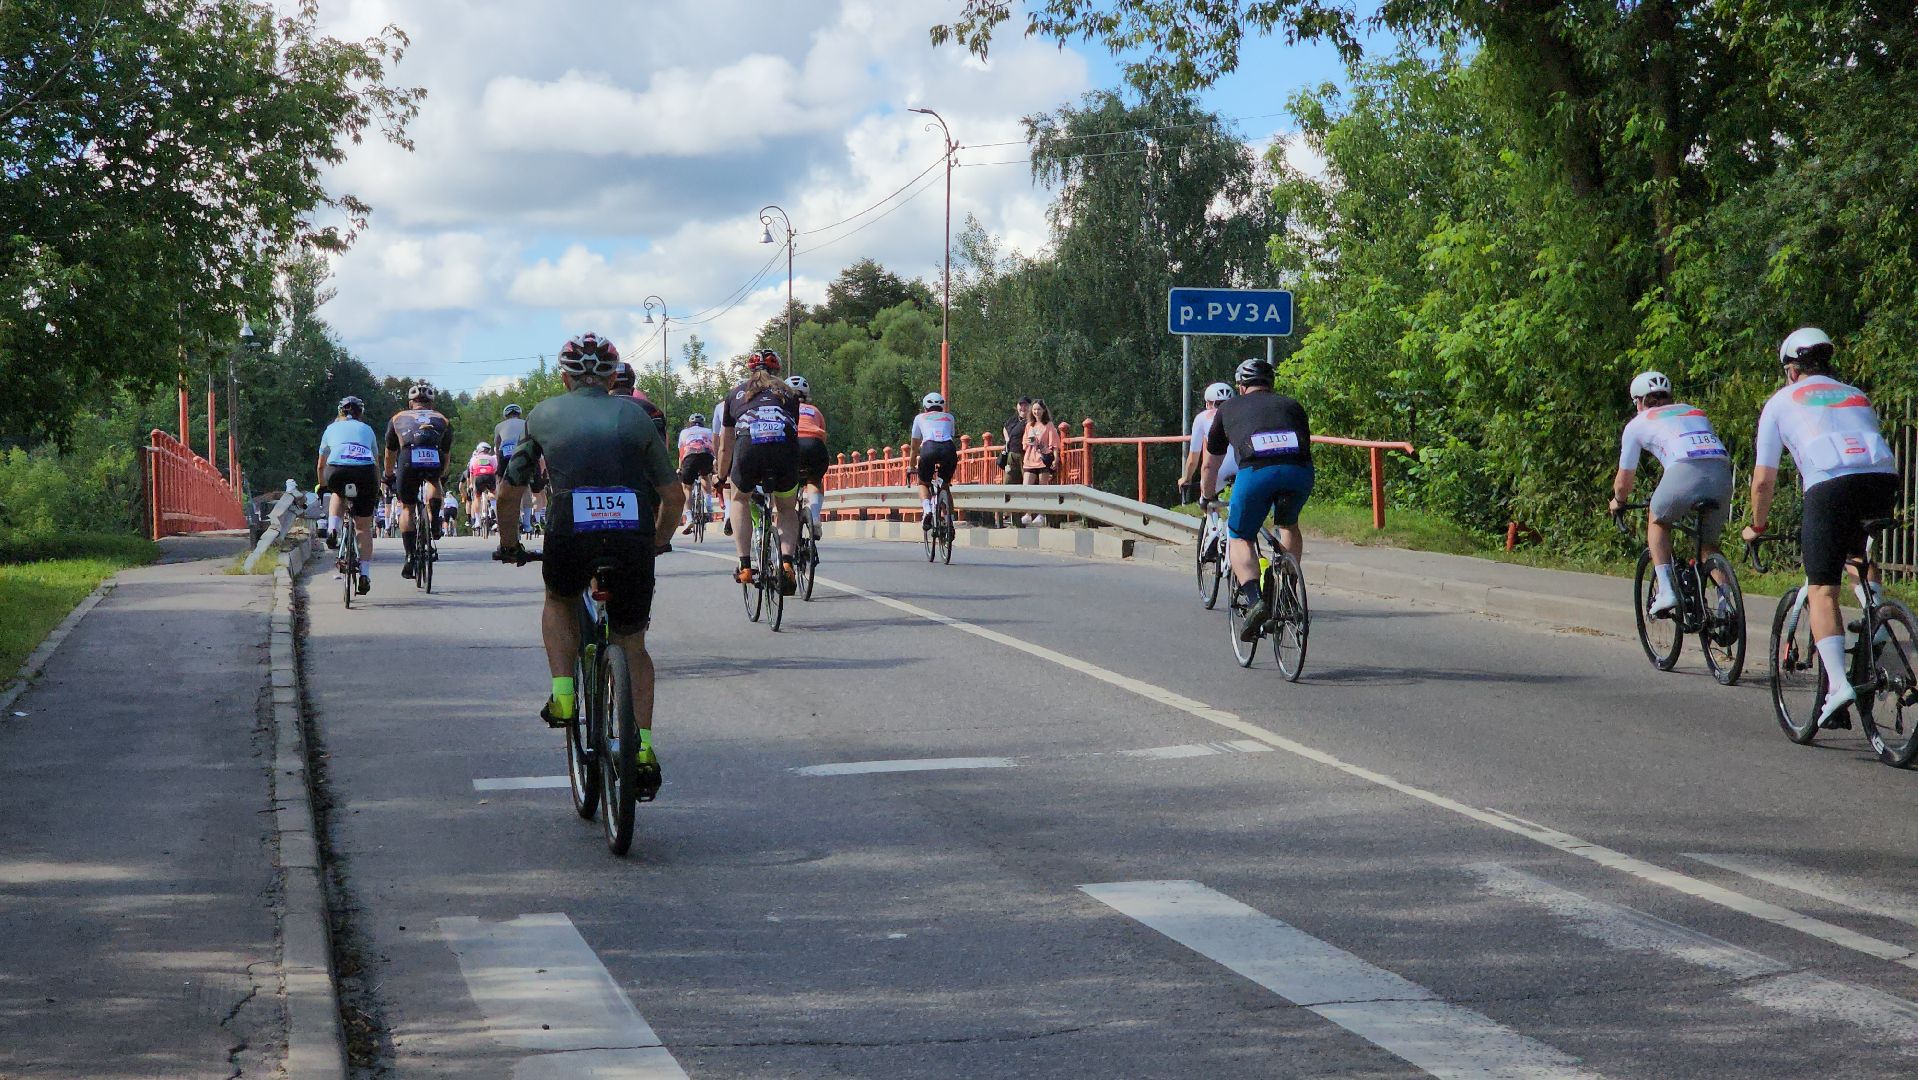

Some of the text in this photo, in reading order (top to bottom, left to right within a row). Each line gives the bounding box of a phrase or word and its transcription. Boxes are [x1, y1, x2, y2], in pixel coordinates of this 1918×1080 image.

[758, 422, 780, 432] 1202
[1261, 434, 1288, 445] 1110
[1690, 435, 1717, 445] 1185
[585, 495, 626, 511] 1154
